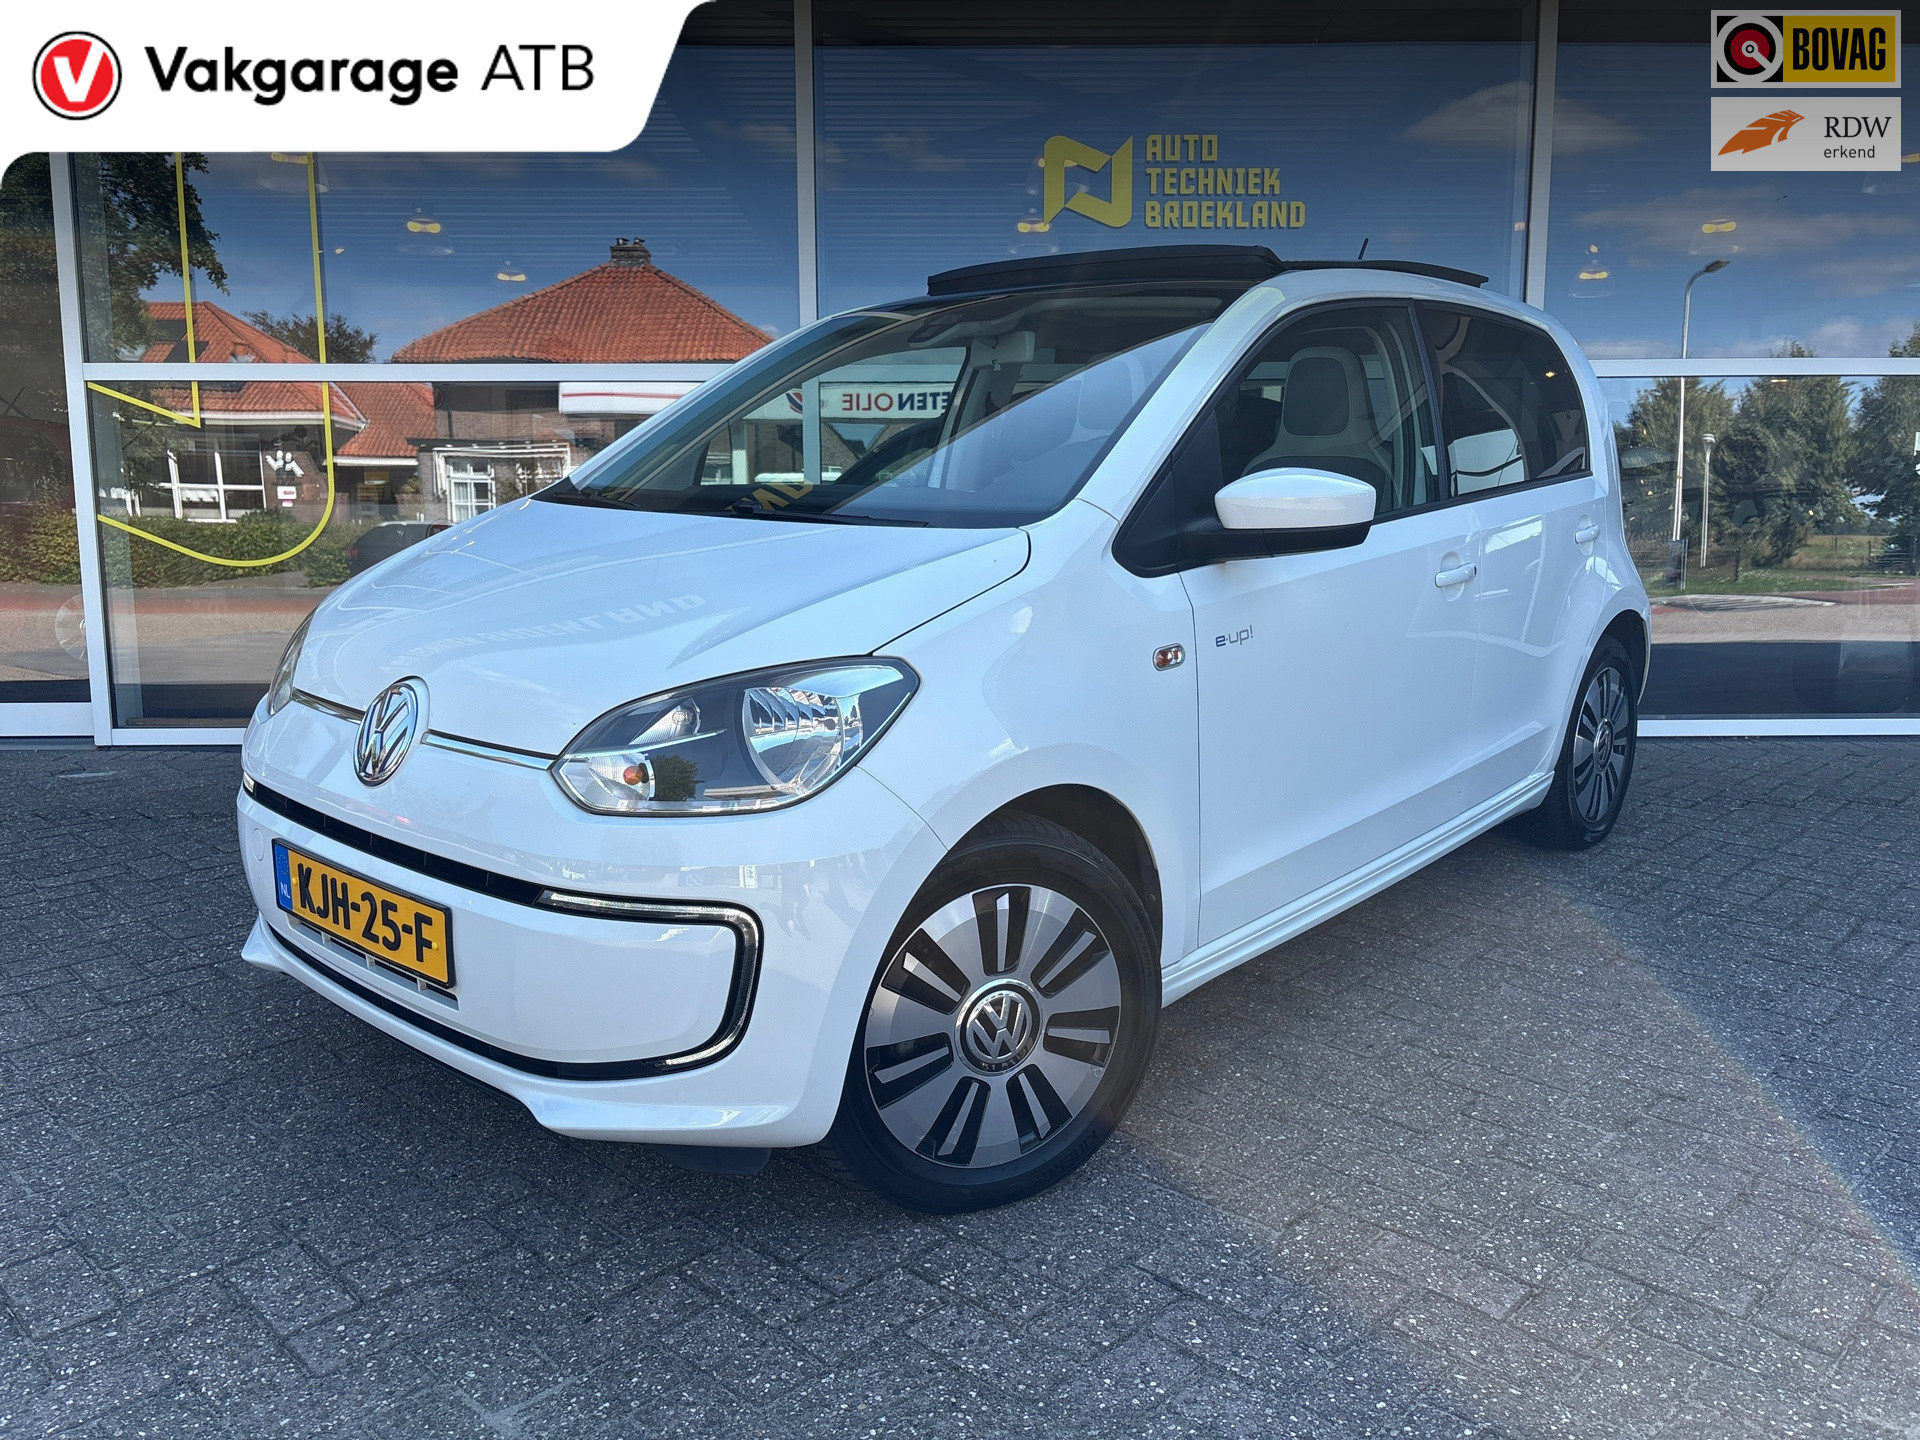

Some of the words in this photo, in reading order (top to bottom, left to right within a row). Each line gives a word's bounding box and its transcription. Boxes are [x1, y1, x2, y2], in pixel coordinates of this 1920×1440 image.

[1145, 134, 1218, 161] AUTO
[1145, 167, 1281, 195] TECHNIEK
[1144, 200, 1307, 229] BROEKLAND
[279, 881, 291, 899] NL
[297, 862, 433, 963] KJH-25-F
